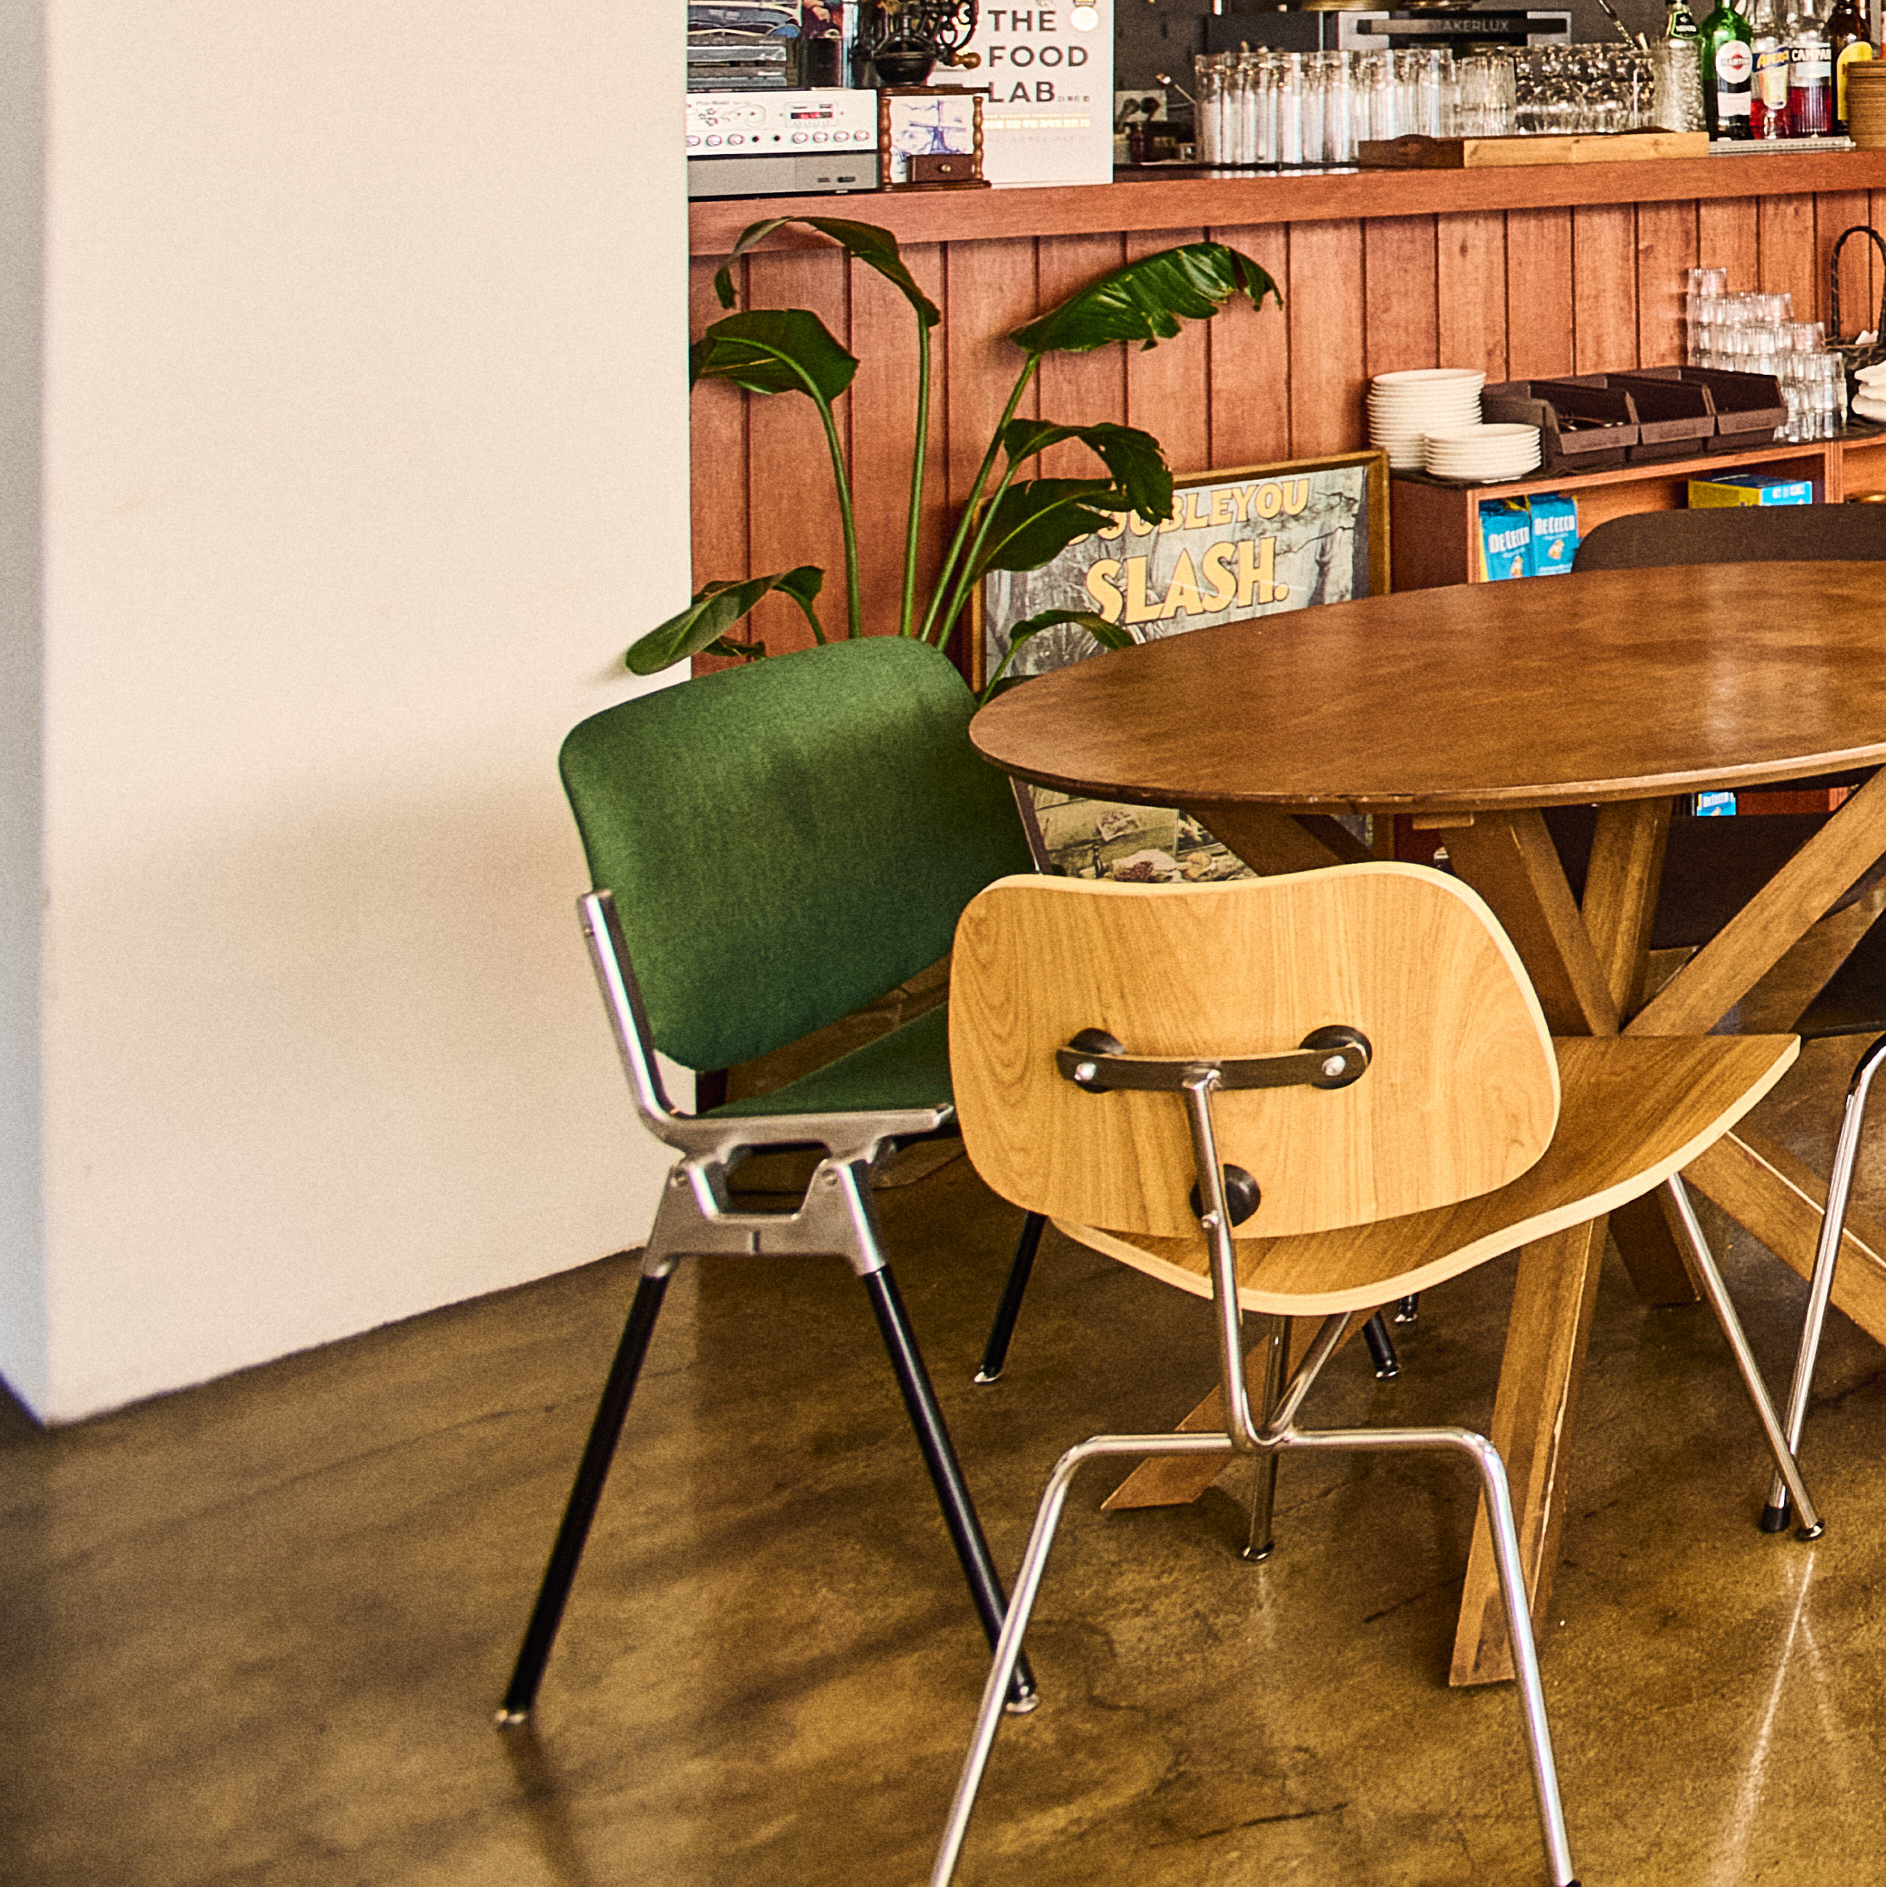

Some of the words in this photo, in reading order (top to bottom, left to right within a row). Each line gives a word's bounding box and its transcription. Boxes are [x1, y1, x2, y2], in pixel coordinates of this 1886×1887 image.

[988, 10, 1057, 32] THE
[1432, 20, 1509, 32] AKERLUX
[988, 45, 1089, 67] FOOD
[1757, 49, 1790, 69] APERO
[1791, 48, 1831, 62] CAMPAR
[988, 82, 1055, 102] LAB
[1086, 536, 1289, 624] SLASH.
